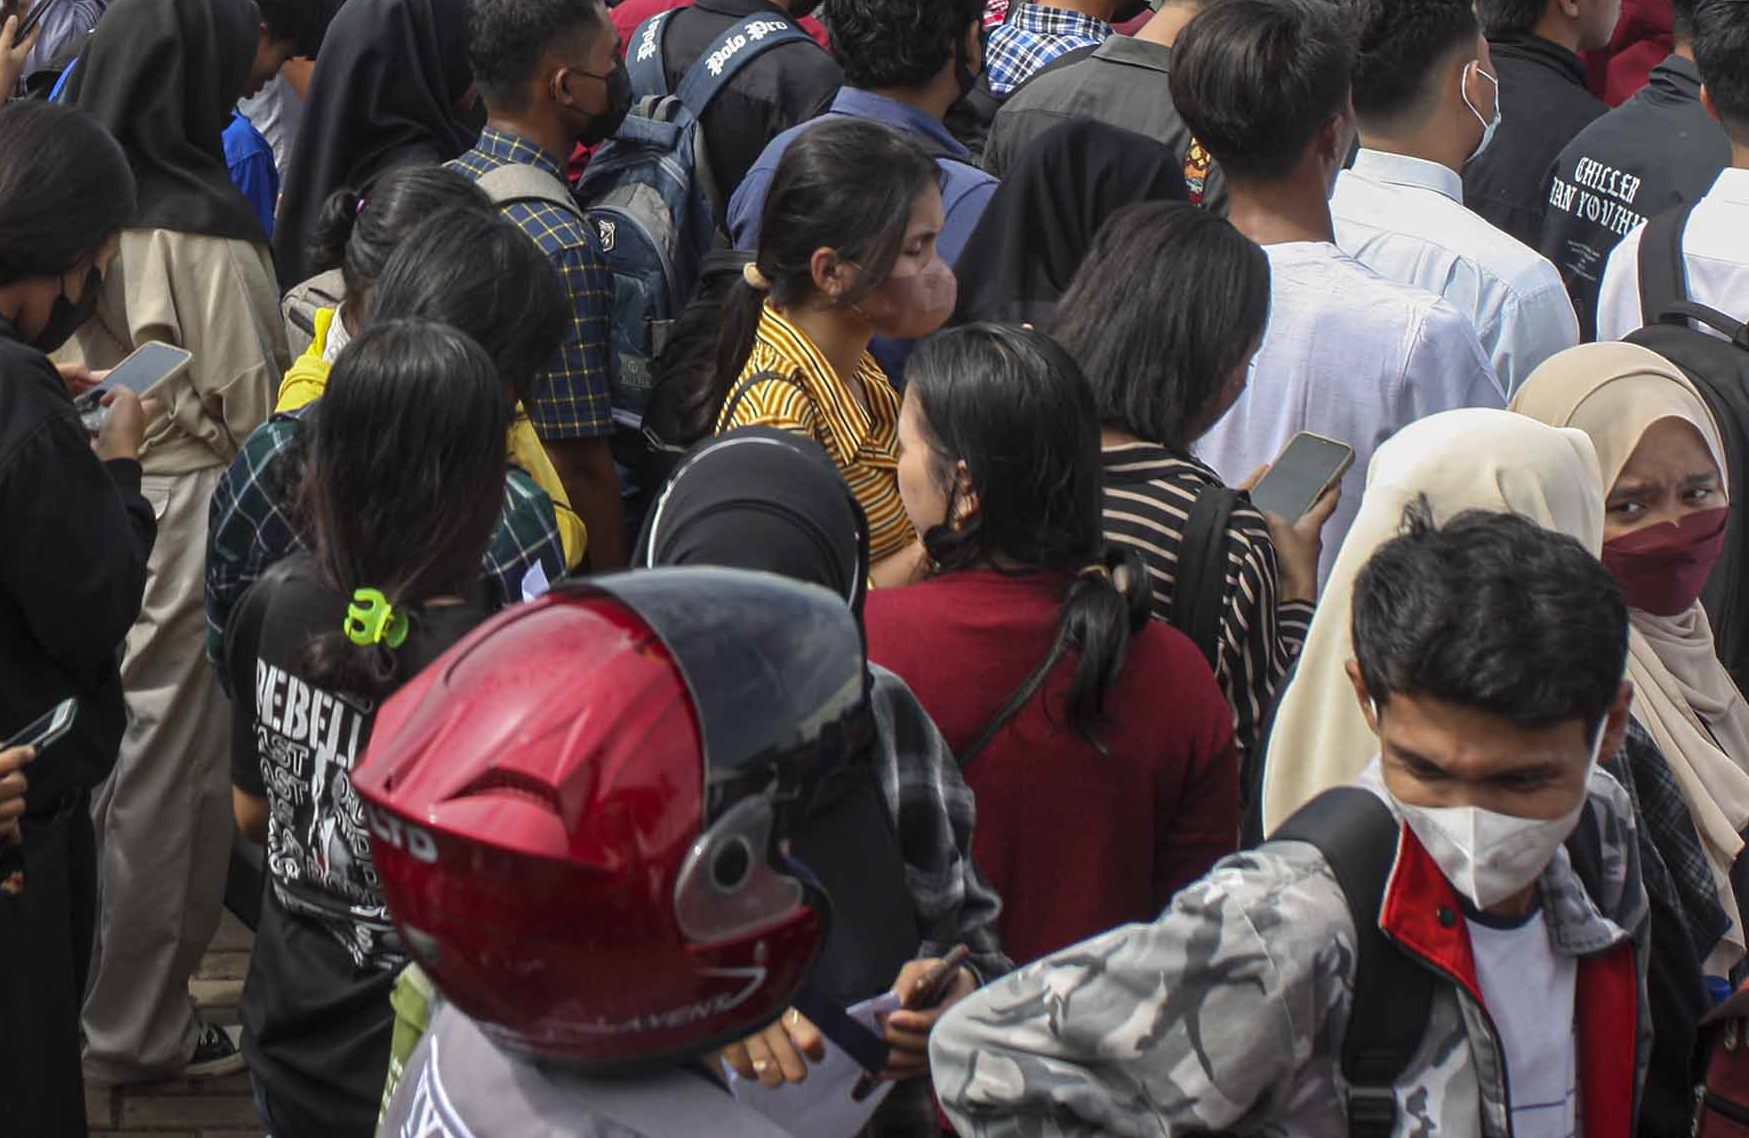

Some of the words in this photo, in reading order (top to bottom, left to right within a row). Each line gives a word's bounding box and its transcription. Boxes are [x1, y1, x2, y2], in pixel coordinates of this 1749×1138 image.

[705, 34, 747, 77] Polo
[744, 20, 789, 41] Pro
[1574, 156, 1641, 204] CHILLER
